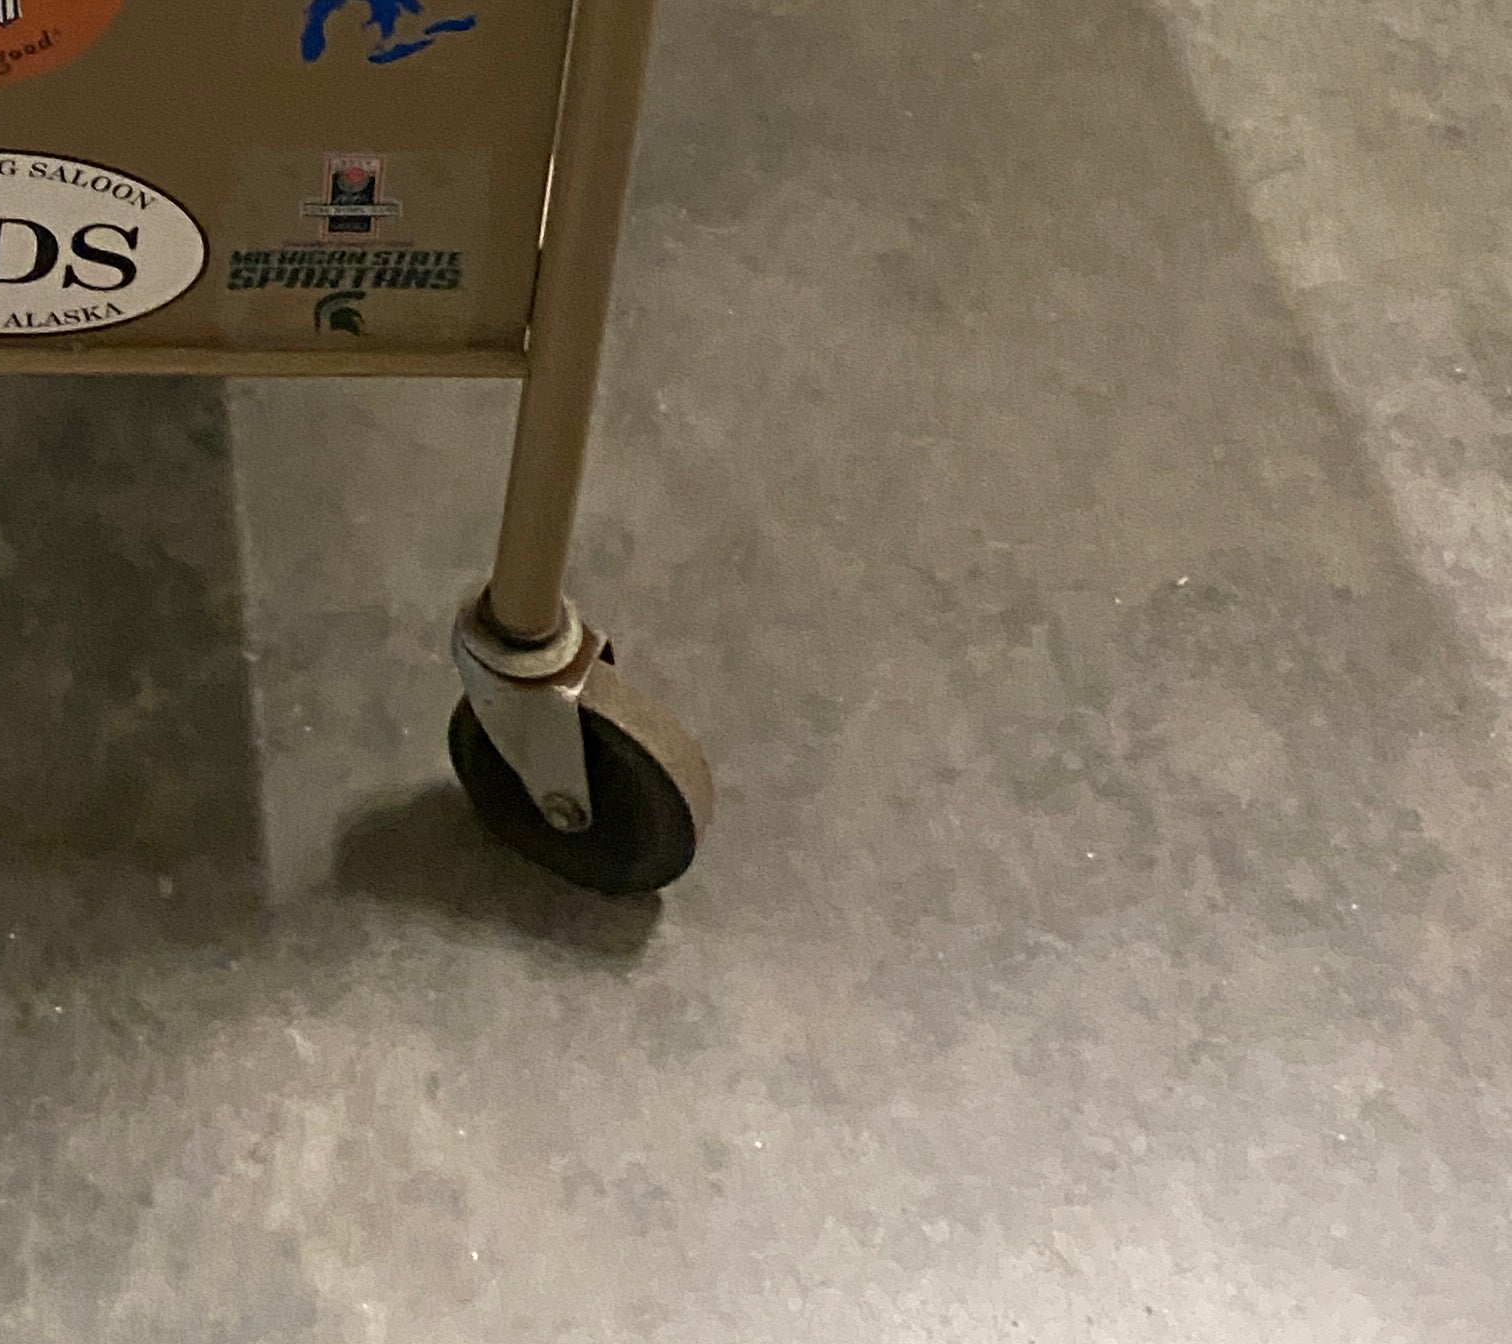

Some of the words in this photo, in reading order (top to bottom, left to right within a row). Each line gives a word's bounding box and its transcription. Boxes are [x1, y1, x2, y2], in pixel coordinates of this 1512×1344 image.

[28, 162, 157, 211] SALOON
[227, 266, 463, 290] SPARTANS
[2, 303, 124, 329] ALASKA
